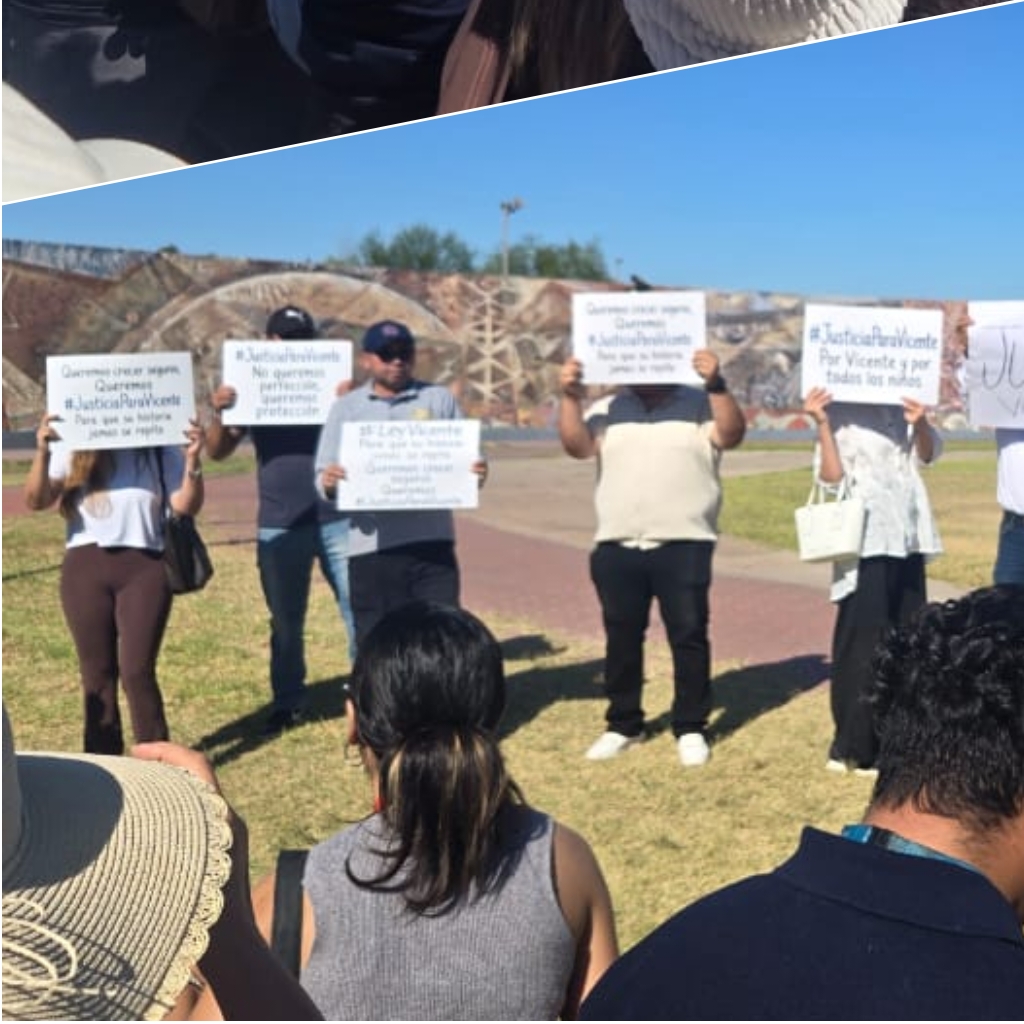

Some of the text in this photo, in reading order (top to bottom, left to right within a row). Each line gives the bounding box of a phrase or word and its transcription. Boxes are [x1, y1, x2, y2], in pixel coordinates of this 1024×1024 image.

[810, 321, 938, 350] #JusticiaParaVicente
[845, 350, 896, 369] Vicente
[911, 360, 932, 374] por
[94, 379, 153, 393] Queremos
[64, 393, 181, 411] #JusticiaParaVicente
